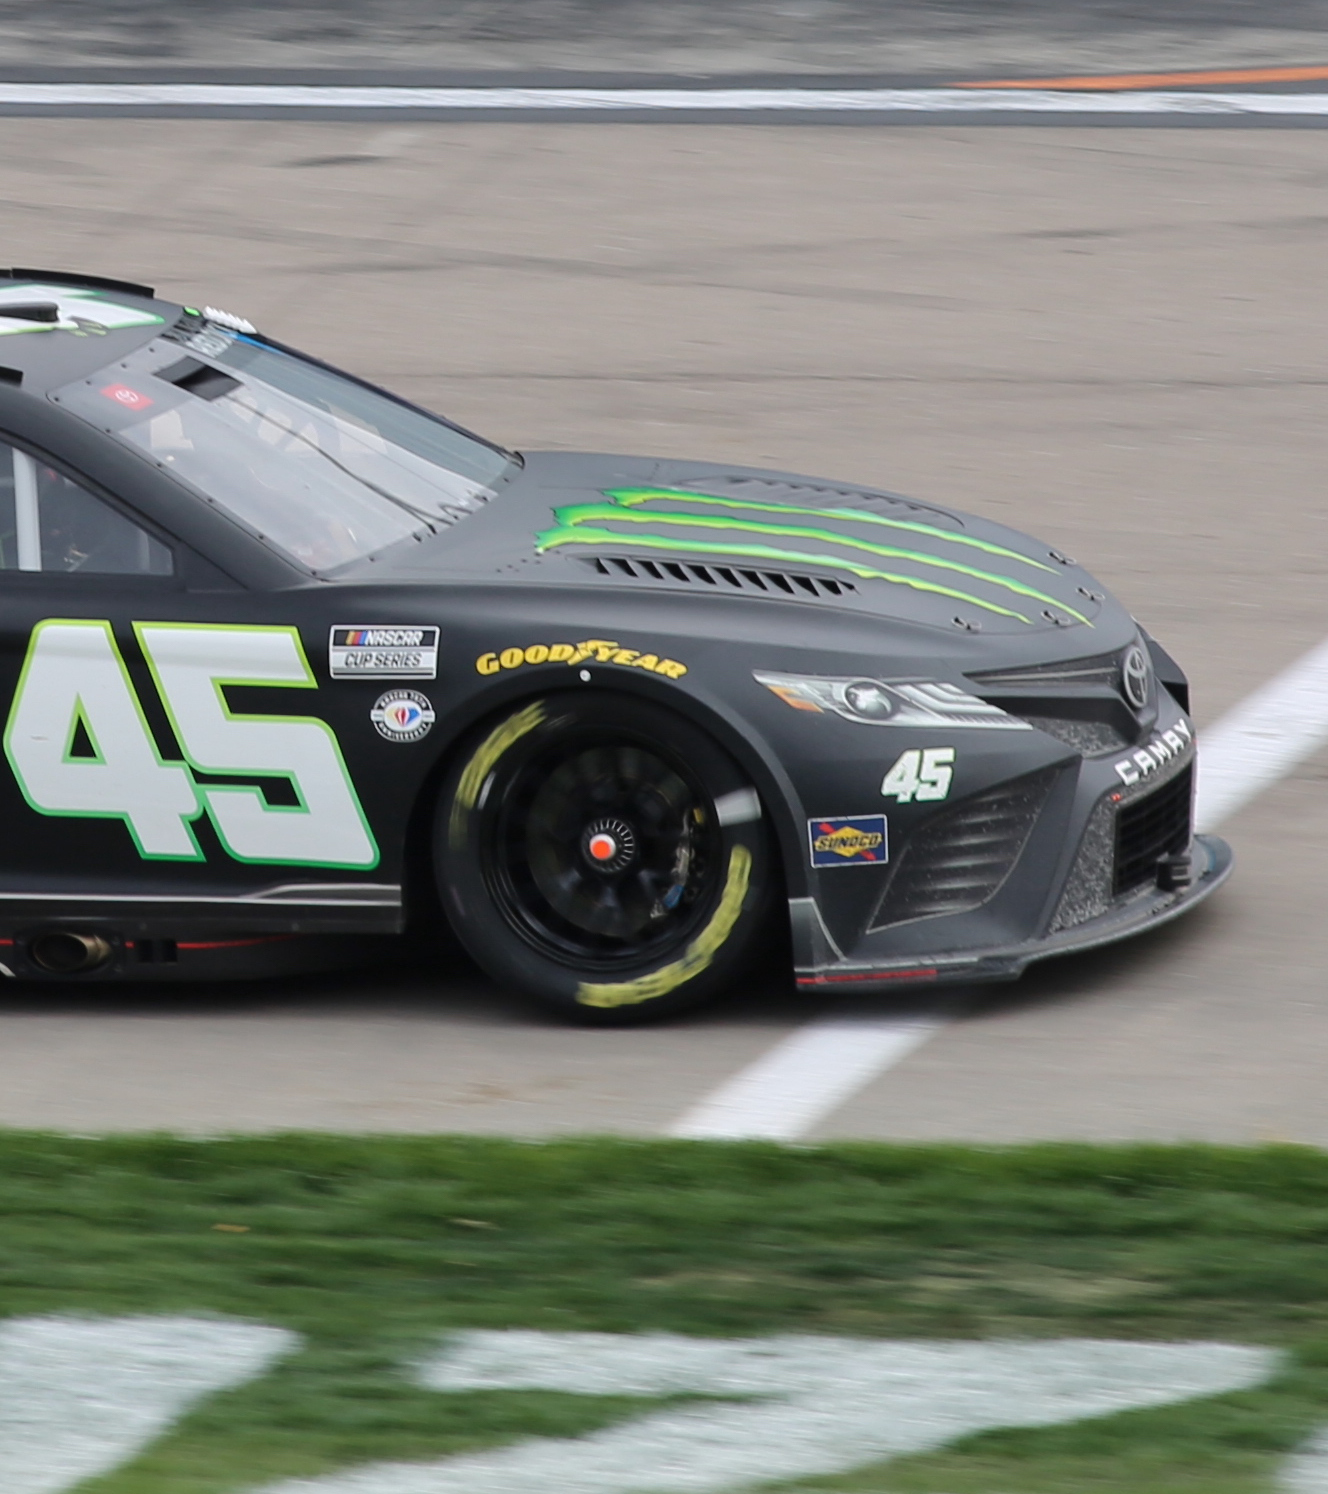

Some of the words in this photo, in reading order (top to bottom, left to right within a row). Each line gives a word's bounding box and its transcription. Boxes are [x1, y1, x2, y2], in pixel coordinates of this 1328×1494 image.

[364, 630, 424, 646] NASCAR
[344, 652, 373, 668] CUP
[373, 652, 423, 668] SERIES
[475, 639, 688, 680] GOODYEAR
[3, 617, 381, 872] 45
[880, 746, 957, 804] 45
[813, 832, 883, 852] SUNOCO
